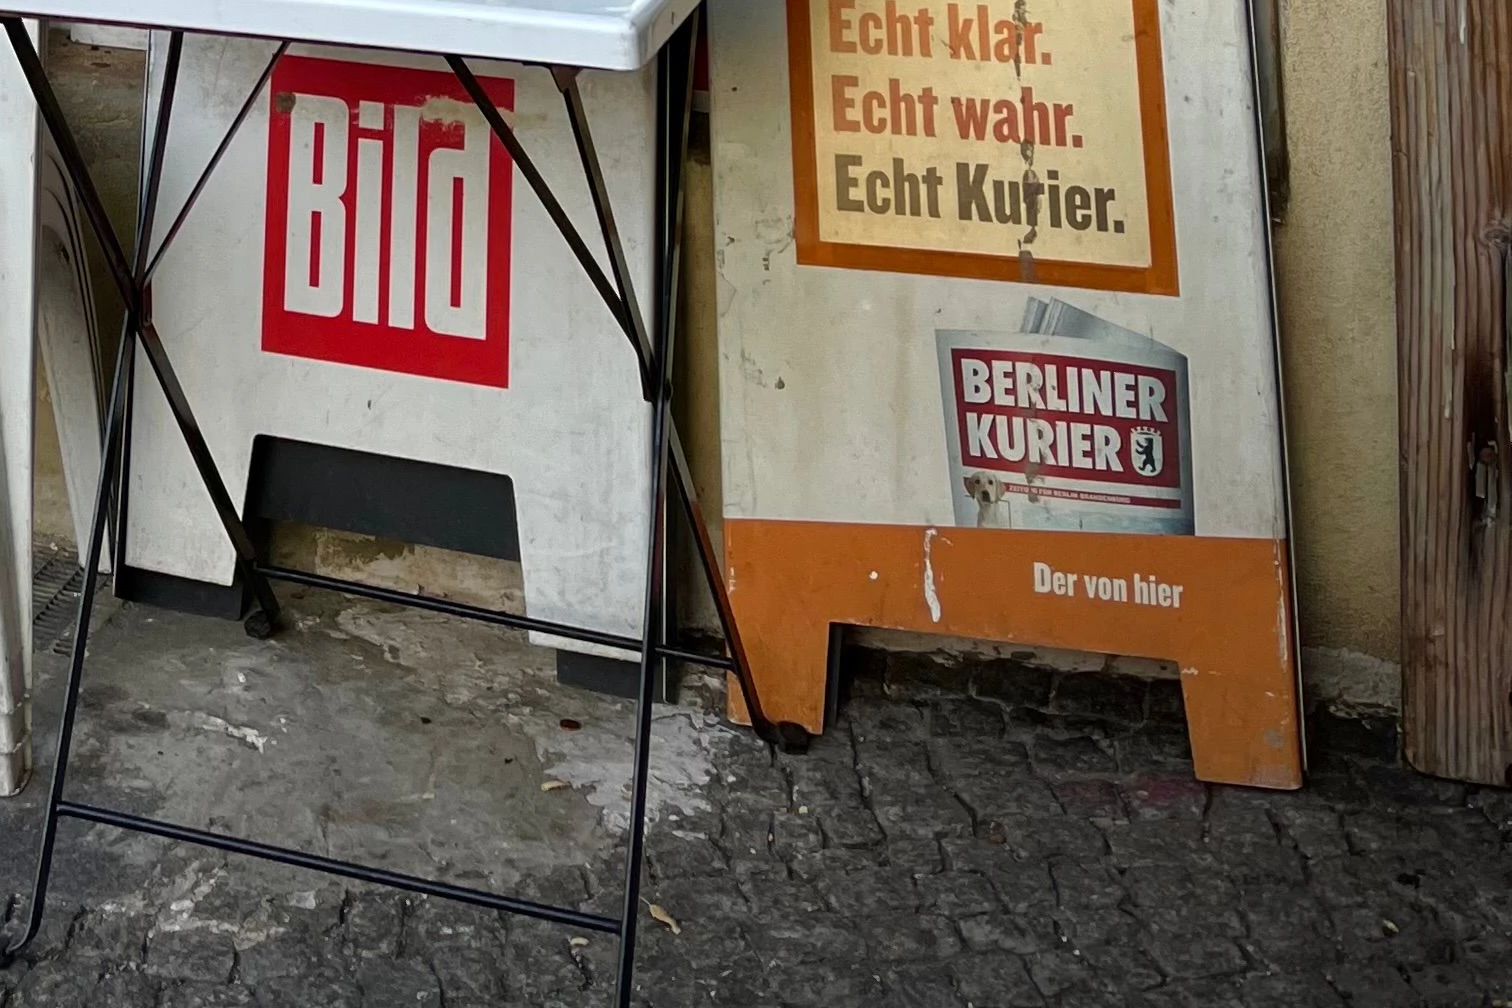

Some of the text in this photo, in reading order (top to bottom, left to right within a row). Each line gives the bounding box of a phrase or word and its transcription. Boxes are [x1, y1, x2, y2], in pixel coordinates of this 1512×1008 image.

[946, 3, 1052, 65] klar.
[831, 75, 1083, 148] Echt wahr.
[283, 92, 492, 340] Bild
[833, 153, 1125, 234] Echt Kurier.
[960, 358, 1168, 422] BERLINER
[965, 412, 1123, 472] KURIER
[1033, 561, 1183, 609] Der von hier
